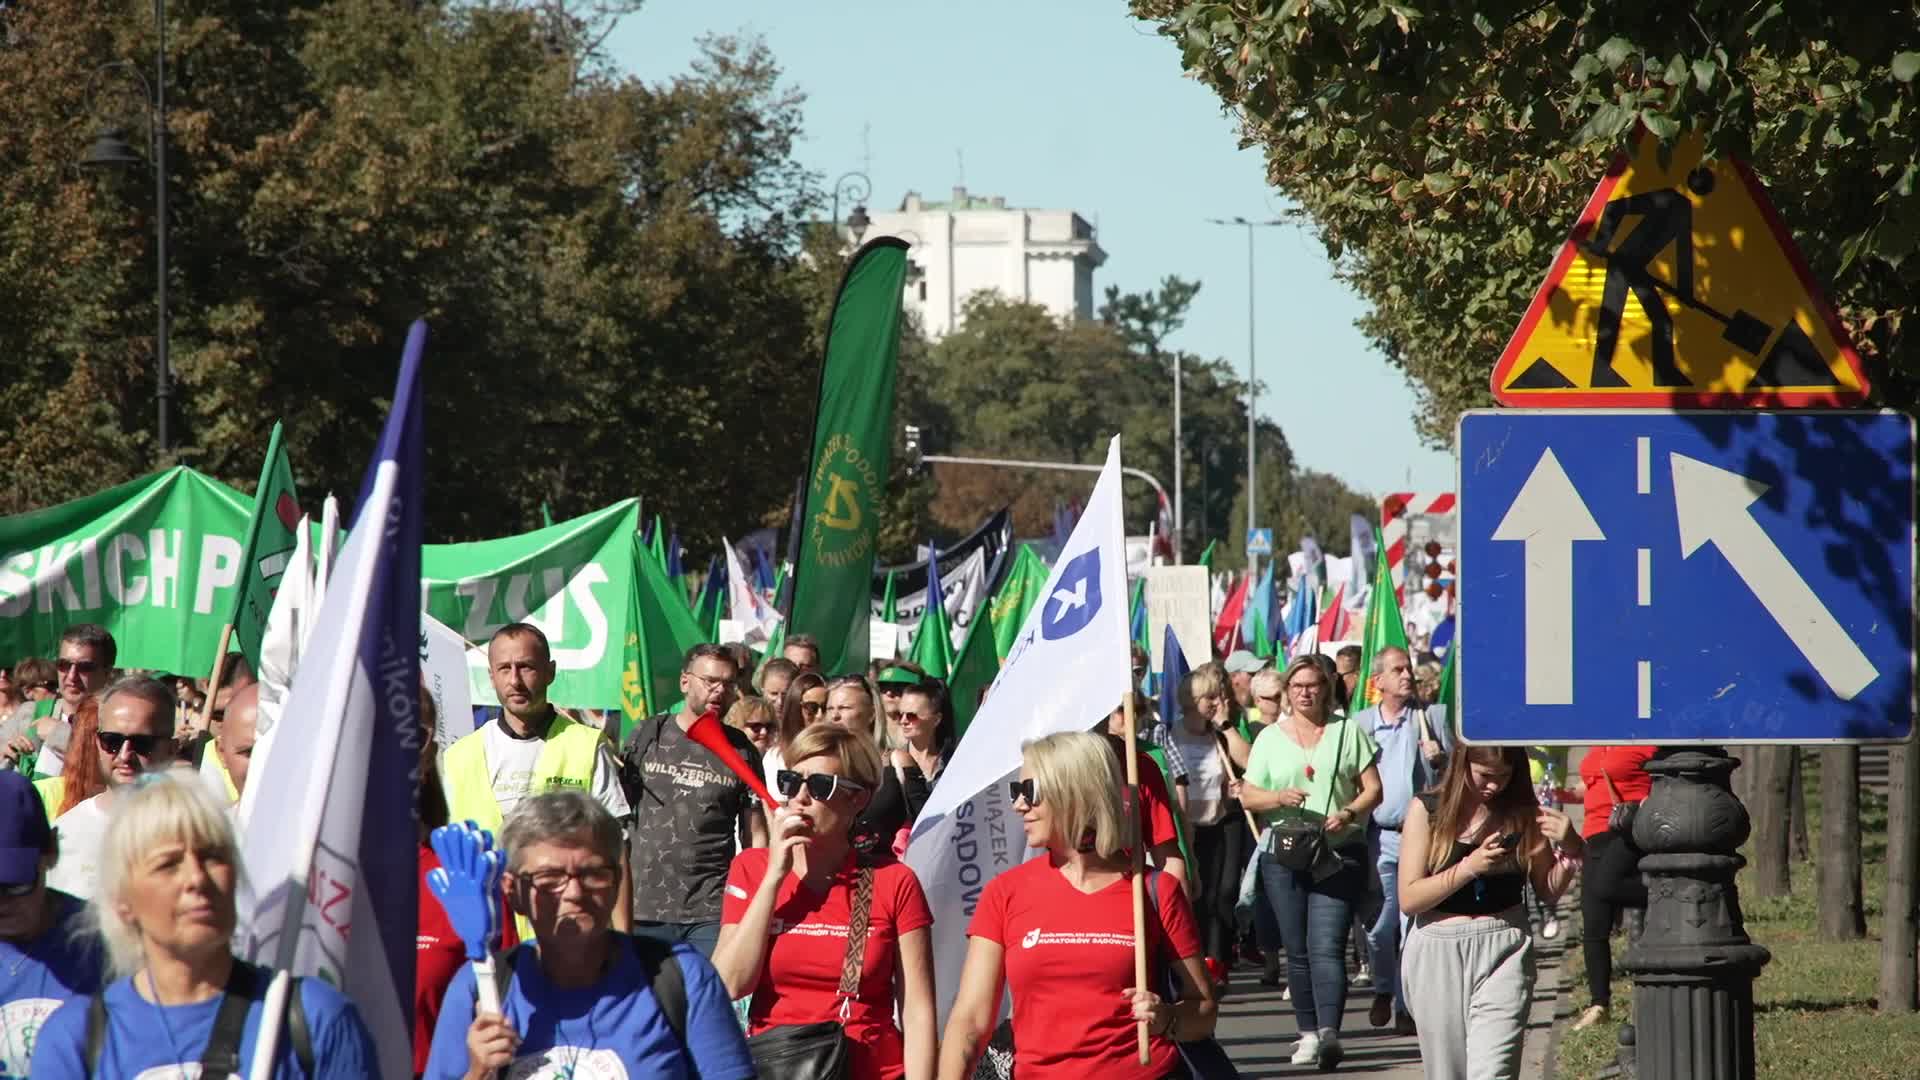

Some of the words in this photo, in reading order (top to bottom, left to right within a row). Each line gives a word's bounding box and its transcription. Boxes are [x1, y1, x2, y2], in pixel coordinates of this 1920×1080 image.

[0, 529, 183, 618] SKICH
[455, 562, 610, 670] ZUS
[644, 761, 677, 777] WILD
